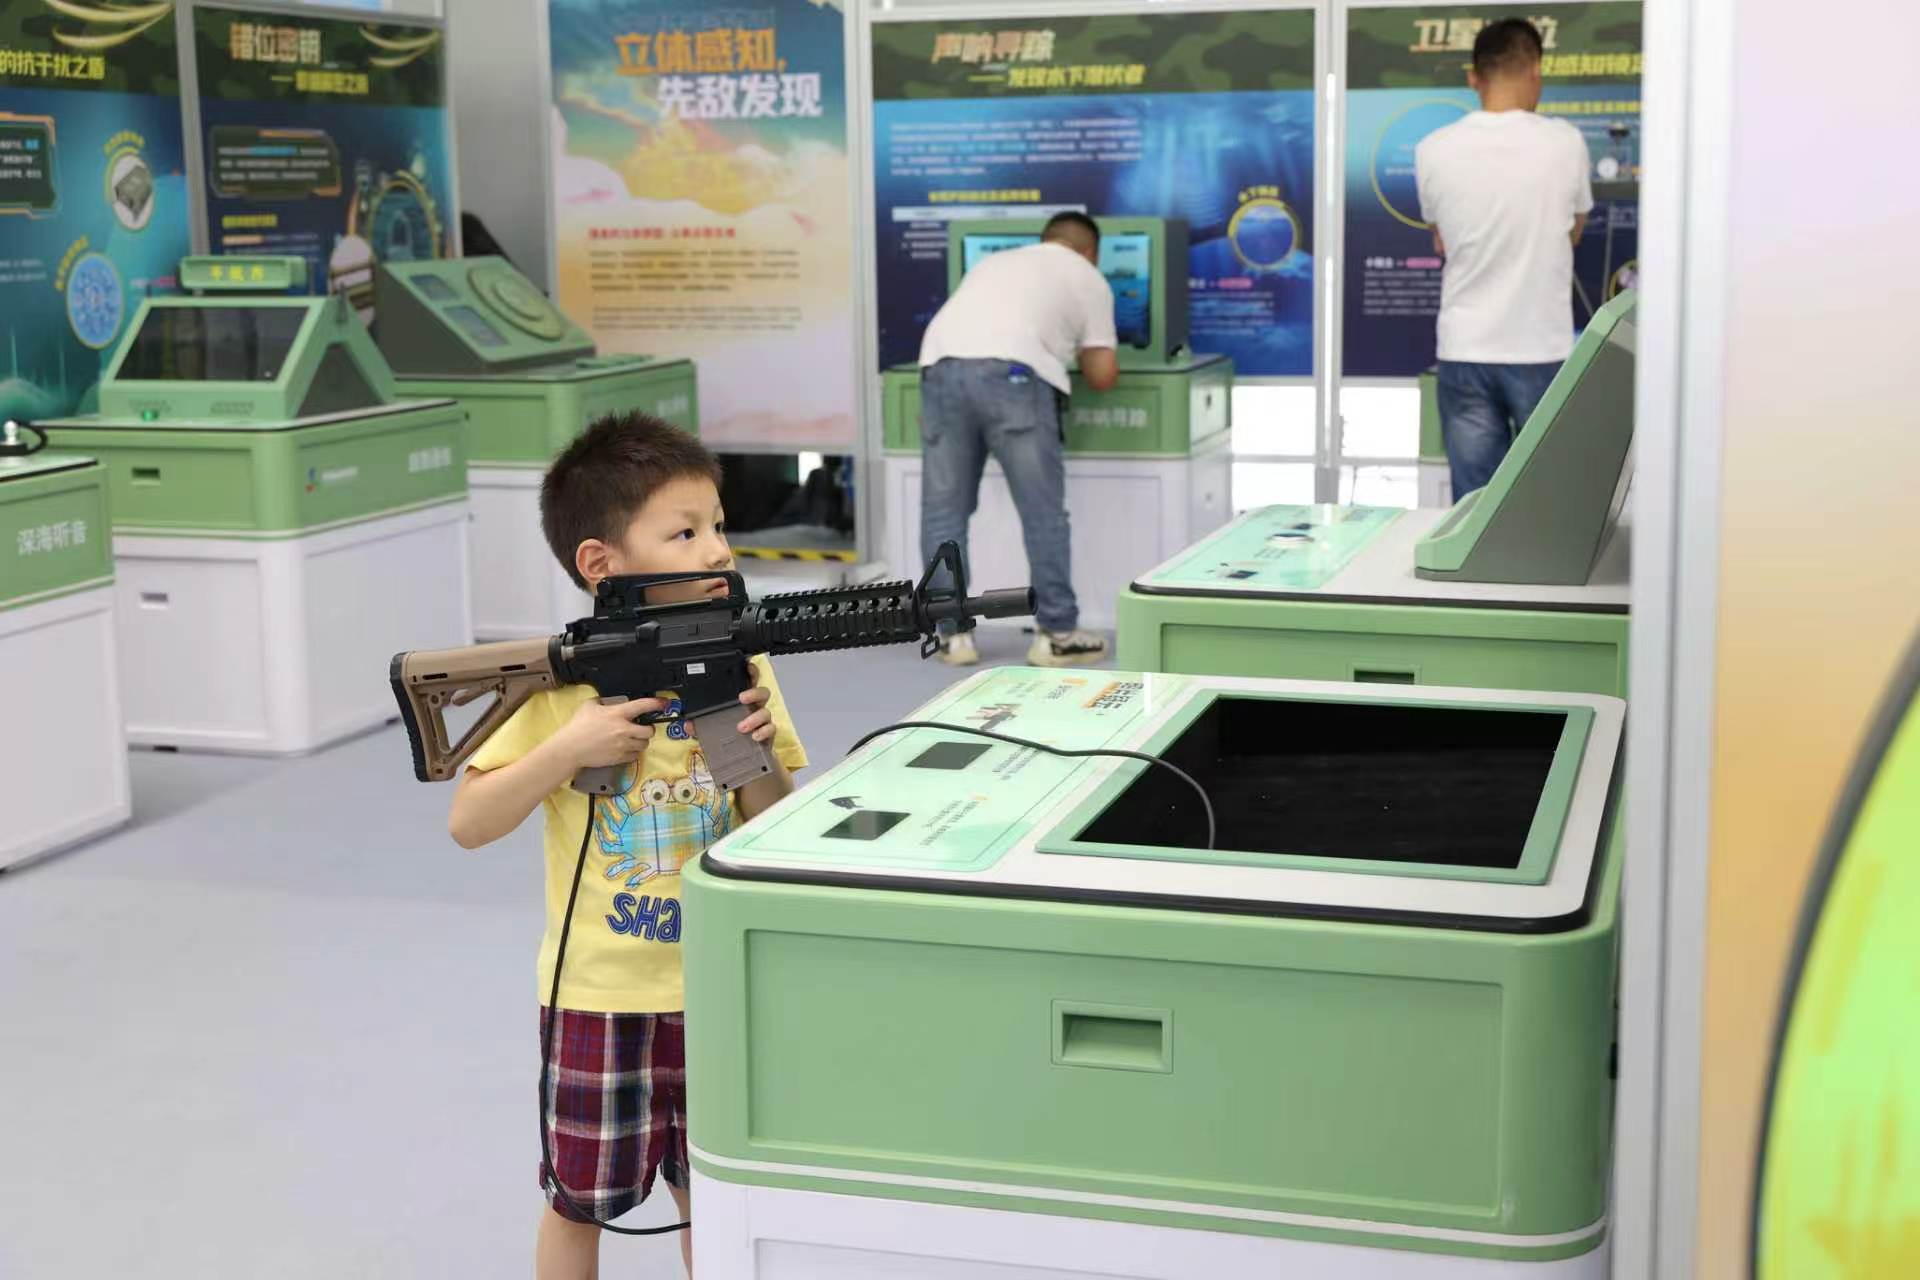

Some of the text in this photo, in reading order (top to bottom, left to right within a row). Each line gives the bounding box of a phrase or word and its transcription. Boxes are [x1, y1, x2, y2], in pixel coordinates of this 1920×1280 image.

[657, 72, 823, 119] 先敌发现
[16, 520, 87, 557] 深海听音
